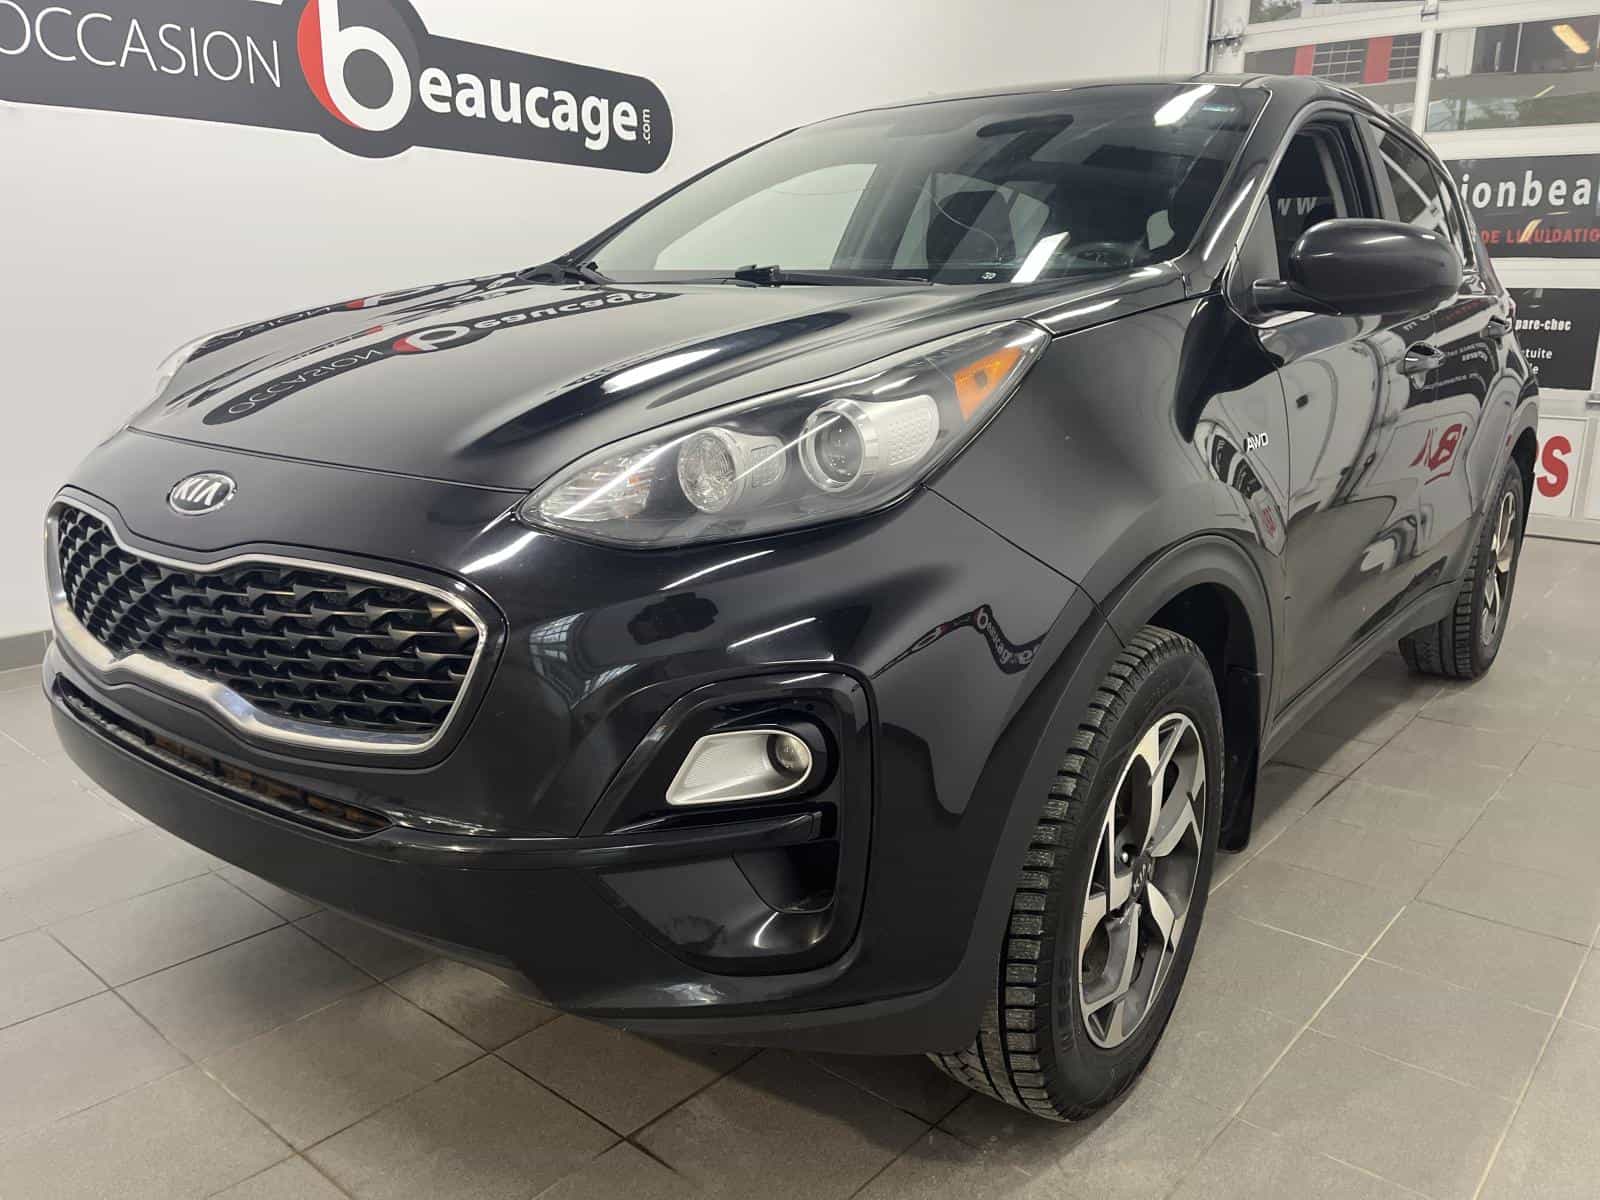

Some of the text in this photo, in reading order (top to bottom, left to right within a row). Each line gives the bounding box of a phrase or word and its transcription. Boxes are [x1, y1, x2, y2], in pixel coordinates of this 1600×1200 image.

[0, 0, 281, 88] OCCASION
[1460, 169, 1600, 209] ionbea
[1246, 432, 1269, 452] AWD
[1536, 435, 1572, 497] S
[173, 477, 223, 506] KIA
